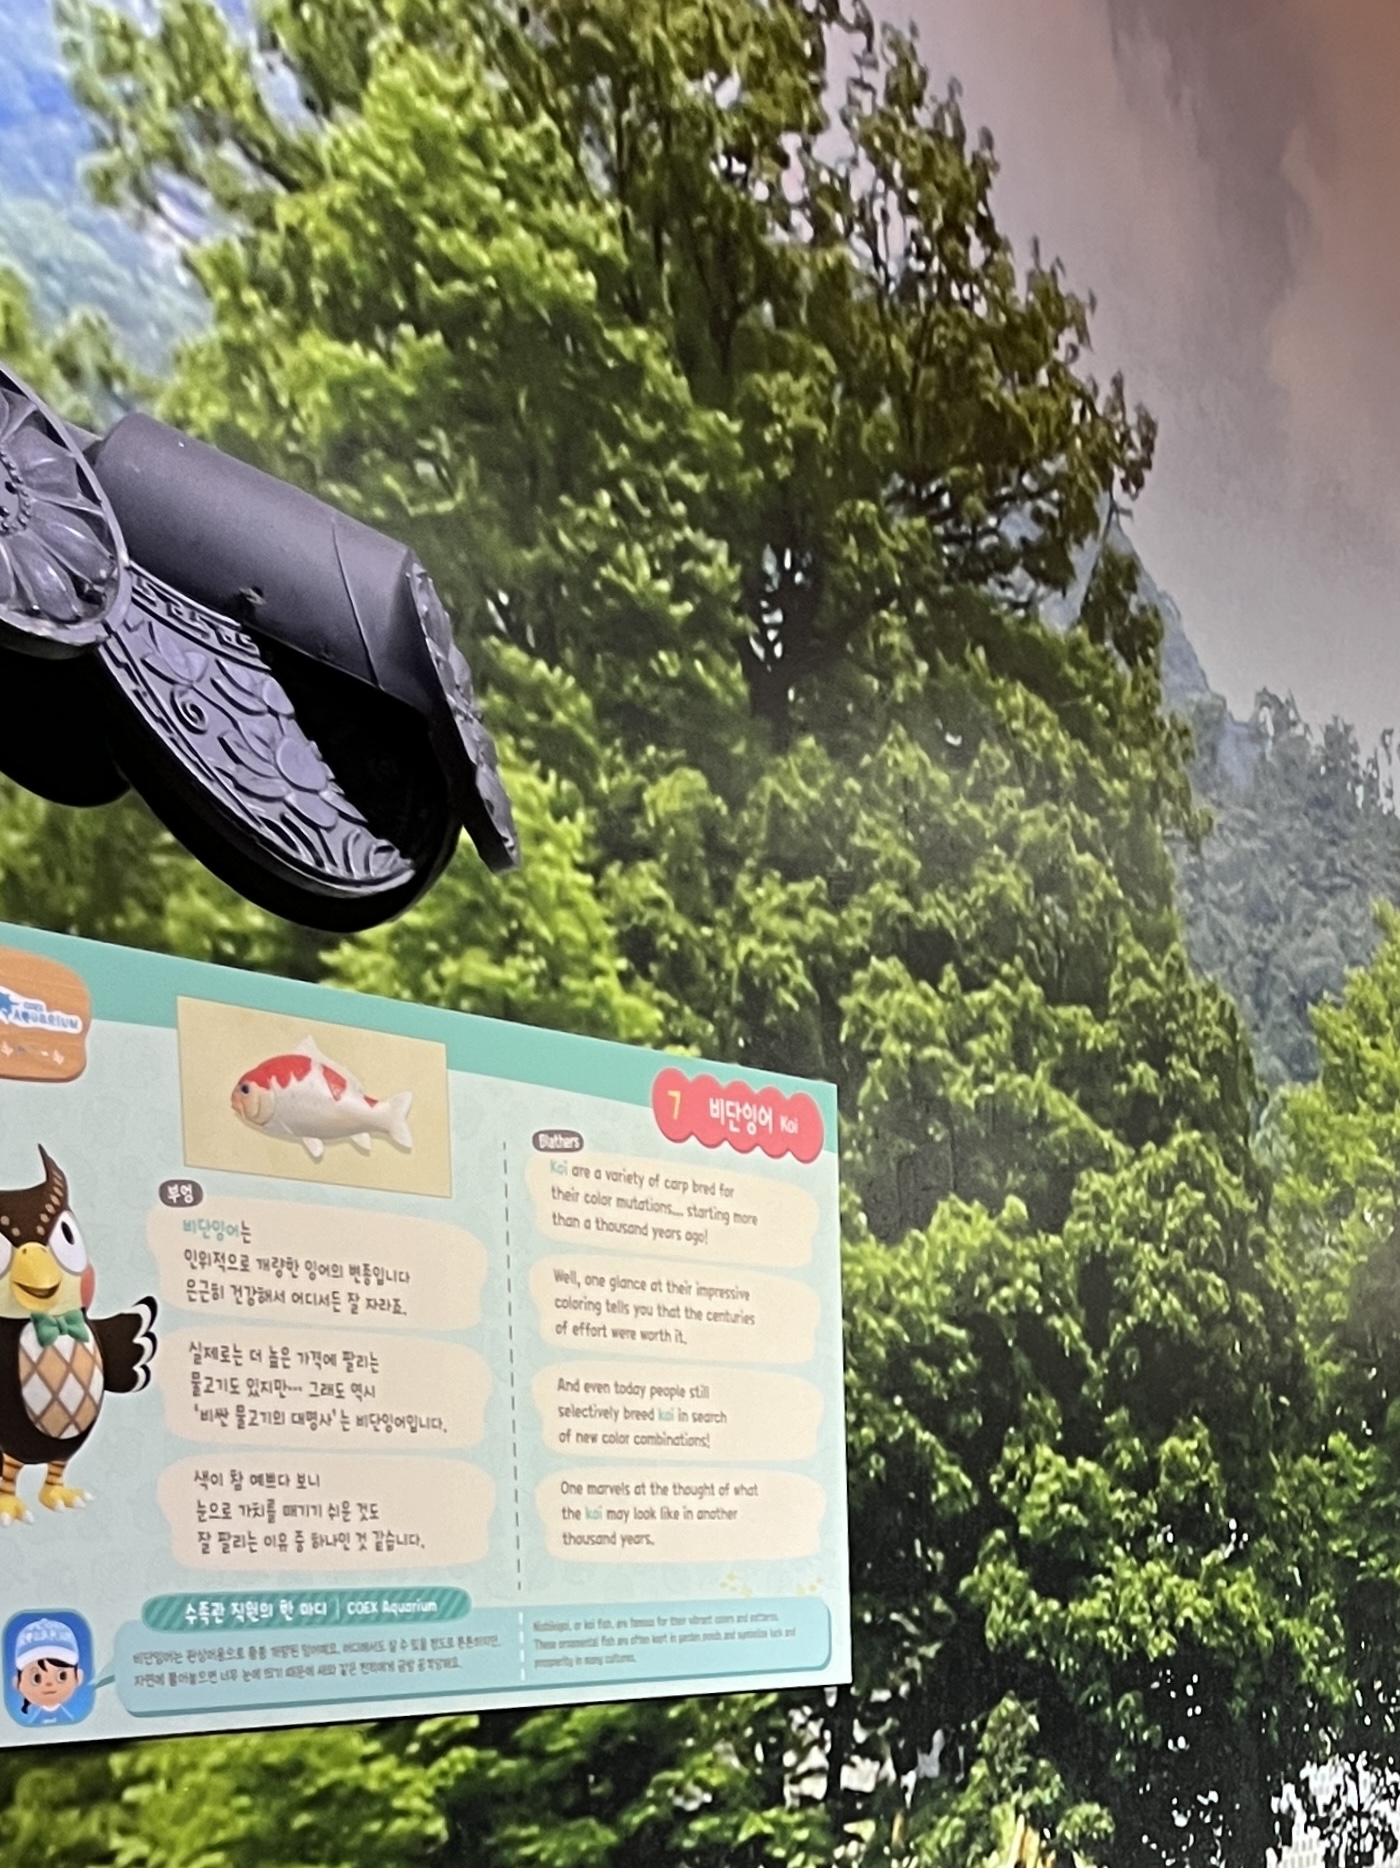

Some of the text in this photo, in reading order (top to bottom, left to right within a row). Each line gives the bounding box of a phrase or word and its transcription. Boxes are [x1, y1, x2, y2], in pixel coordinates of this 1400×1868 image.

[668, 1090, 798, 1135] 7 비단잉어 Koi
[550, 1160, 734, 1198] Koi are a variety of carp bred for
[167, 1184, 192, 1204] 부엉
[552, 1187, 579, 1203] their
[584, 1191, 612, 1206] color
[687, 1205, 730, 1226] starting
[734, 1213, 758, 1226] more
[183, 1218, 251, 1244] 비단잉어는
[553, 1213, 708, 1245] than a thousand years ago!
[184, 1249, 410, 1285] 인위적으로 개량한 잉어의 변종입니다
[554, 1268, 750, 1301] Well, one glance at their impressive
[186, 1280, 407, 1316] 은근히 건강해서 어디서든 잘 자라죠.
[554, 1296, 755, 1325] coloring tells you that the centuries
[556, 1321, 687, 1344] of effort were worth it.
[189, 1341, 378, 1373] 실제로는 더 높은 가격에 팔리는
[191, 1371, 240, 1396] 물고기도
[309, 1382, 345, 1399] 그래도
[351, 1383, 376, 1402] 역시
[558, 1378, 709, 1400] And even today people still
[236, 1404, 285, 1429] 물고기의
[356, 1413, 448, 1434] 비단잉어입니다.
[558, 1404, 727, 1423] selectively breed koi in search
[559, 1429, 710, 1448] of new color combinations!
[194, 1469, 320, 1491] 색이 참 예쁘다 보니
[561, 1480, 758, 1500] One marvels at the thought of what
[196, 1499, 379, 1524] 눈으로 가치를 매기기 쉬운 것도
[562, 1506, 738, 1523] the koi may look like in another
[198, 1530, 425, 1554] 잘 팔리는 이유 중 하나인 것 같습니다.
[562, 1532, 654, 1548] thousand years.
[185, 1600, 437, 1624] 수족관 직원의 한 마디 COEX Aquarium
